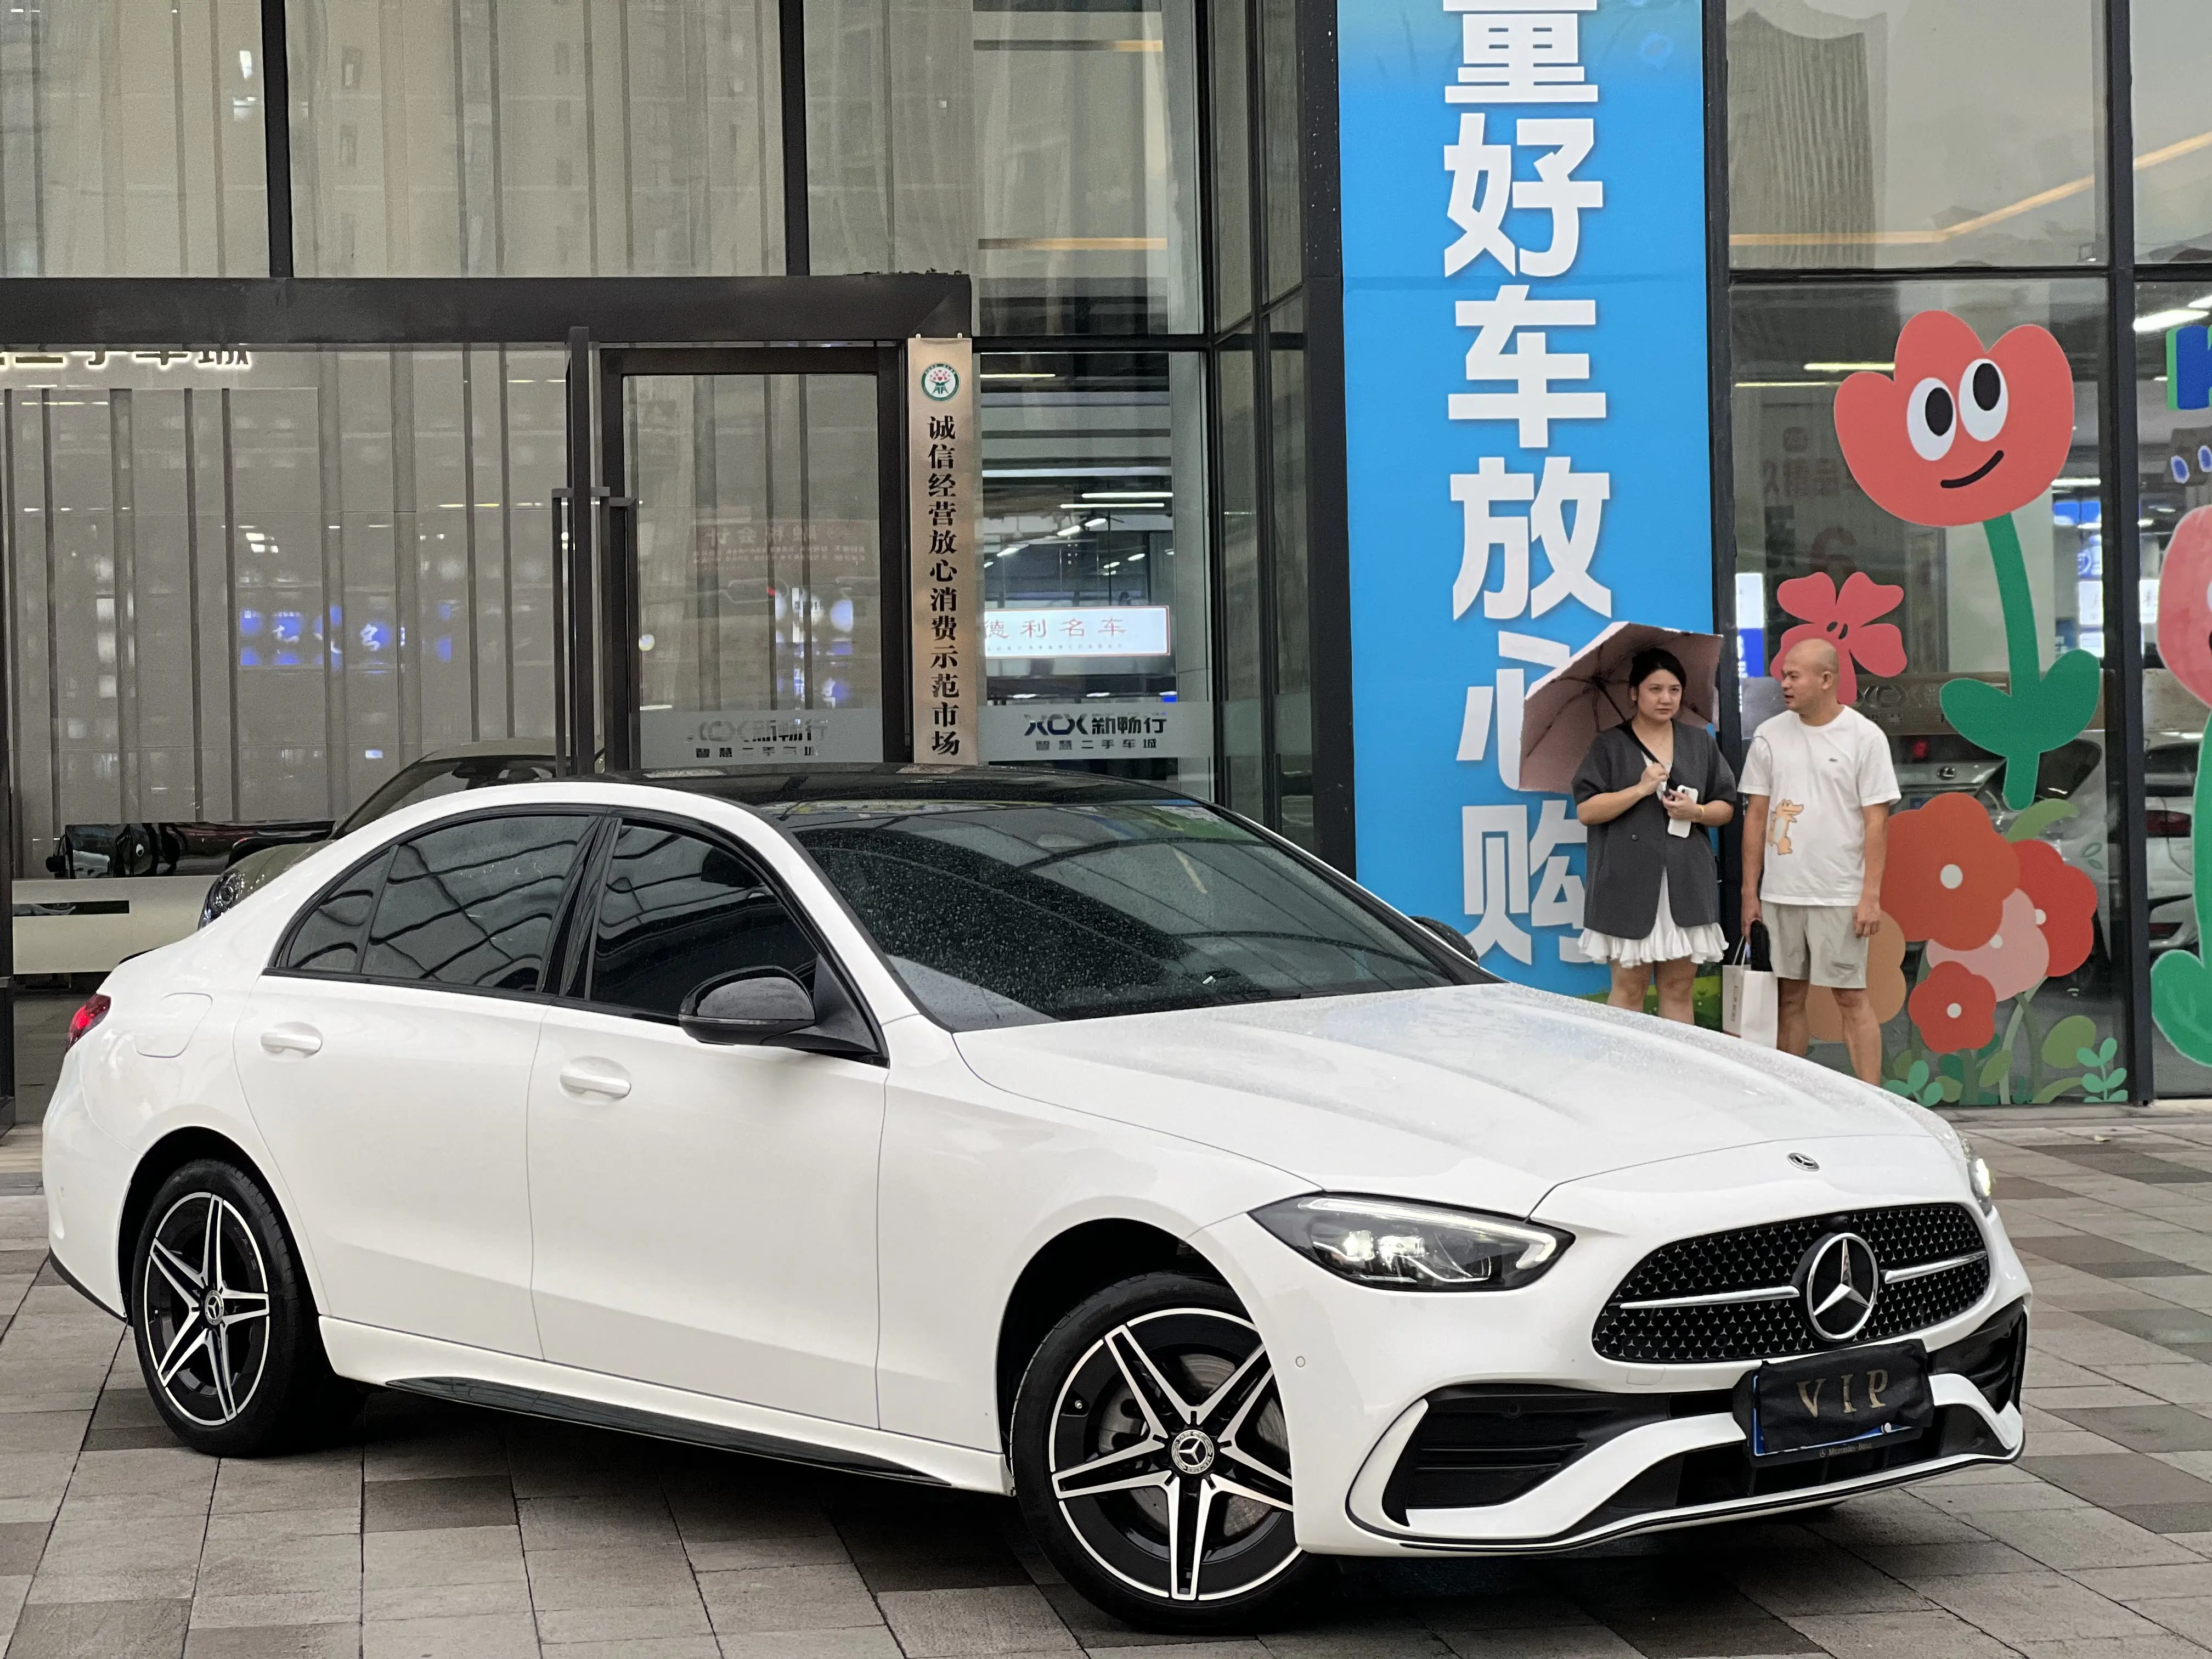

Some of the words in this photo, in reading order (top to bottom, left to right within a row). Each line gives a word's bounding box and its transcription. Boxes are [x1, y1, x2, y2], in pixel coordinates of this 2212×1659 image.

[927, 415, 960, 757] 诚信经营放心消费示范市场
[1796, 1369, 1889, 1418] VIP
